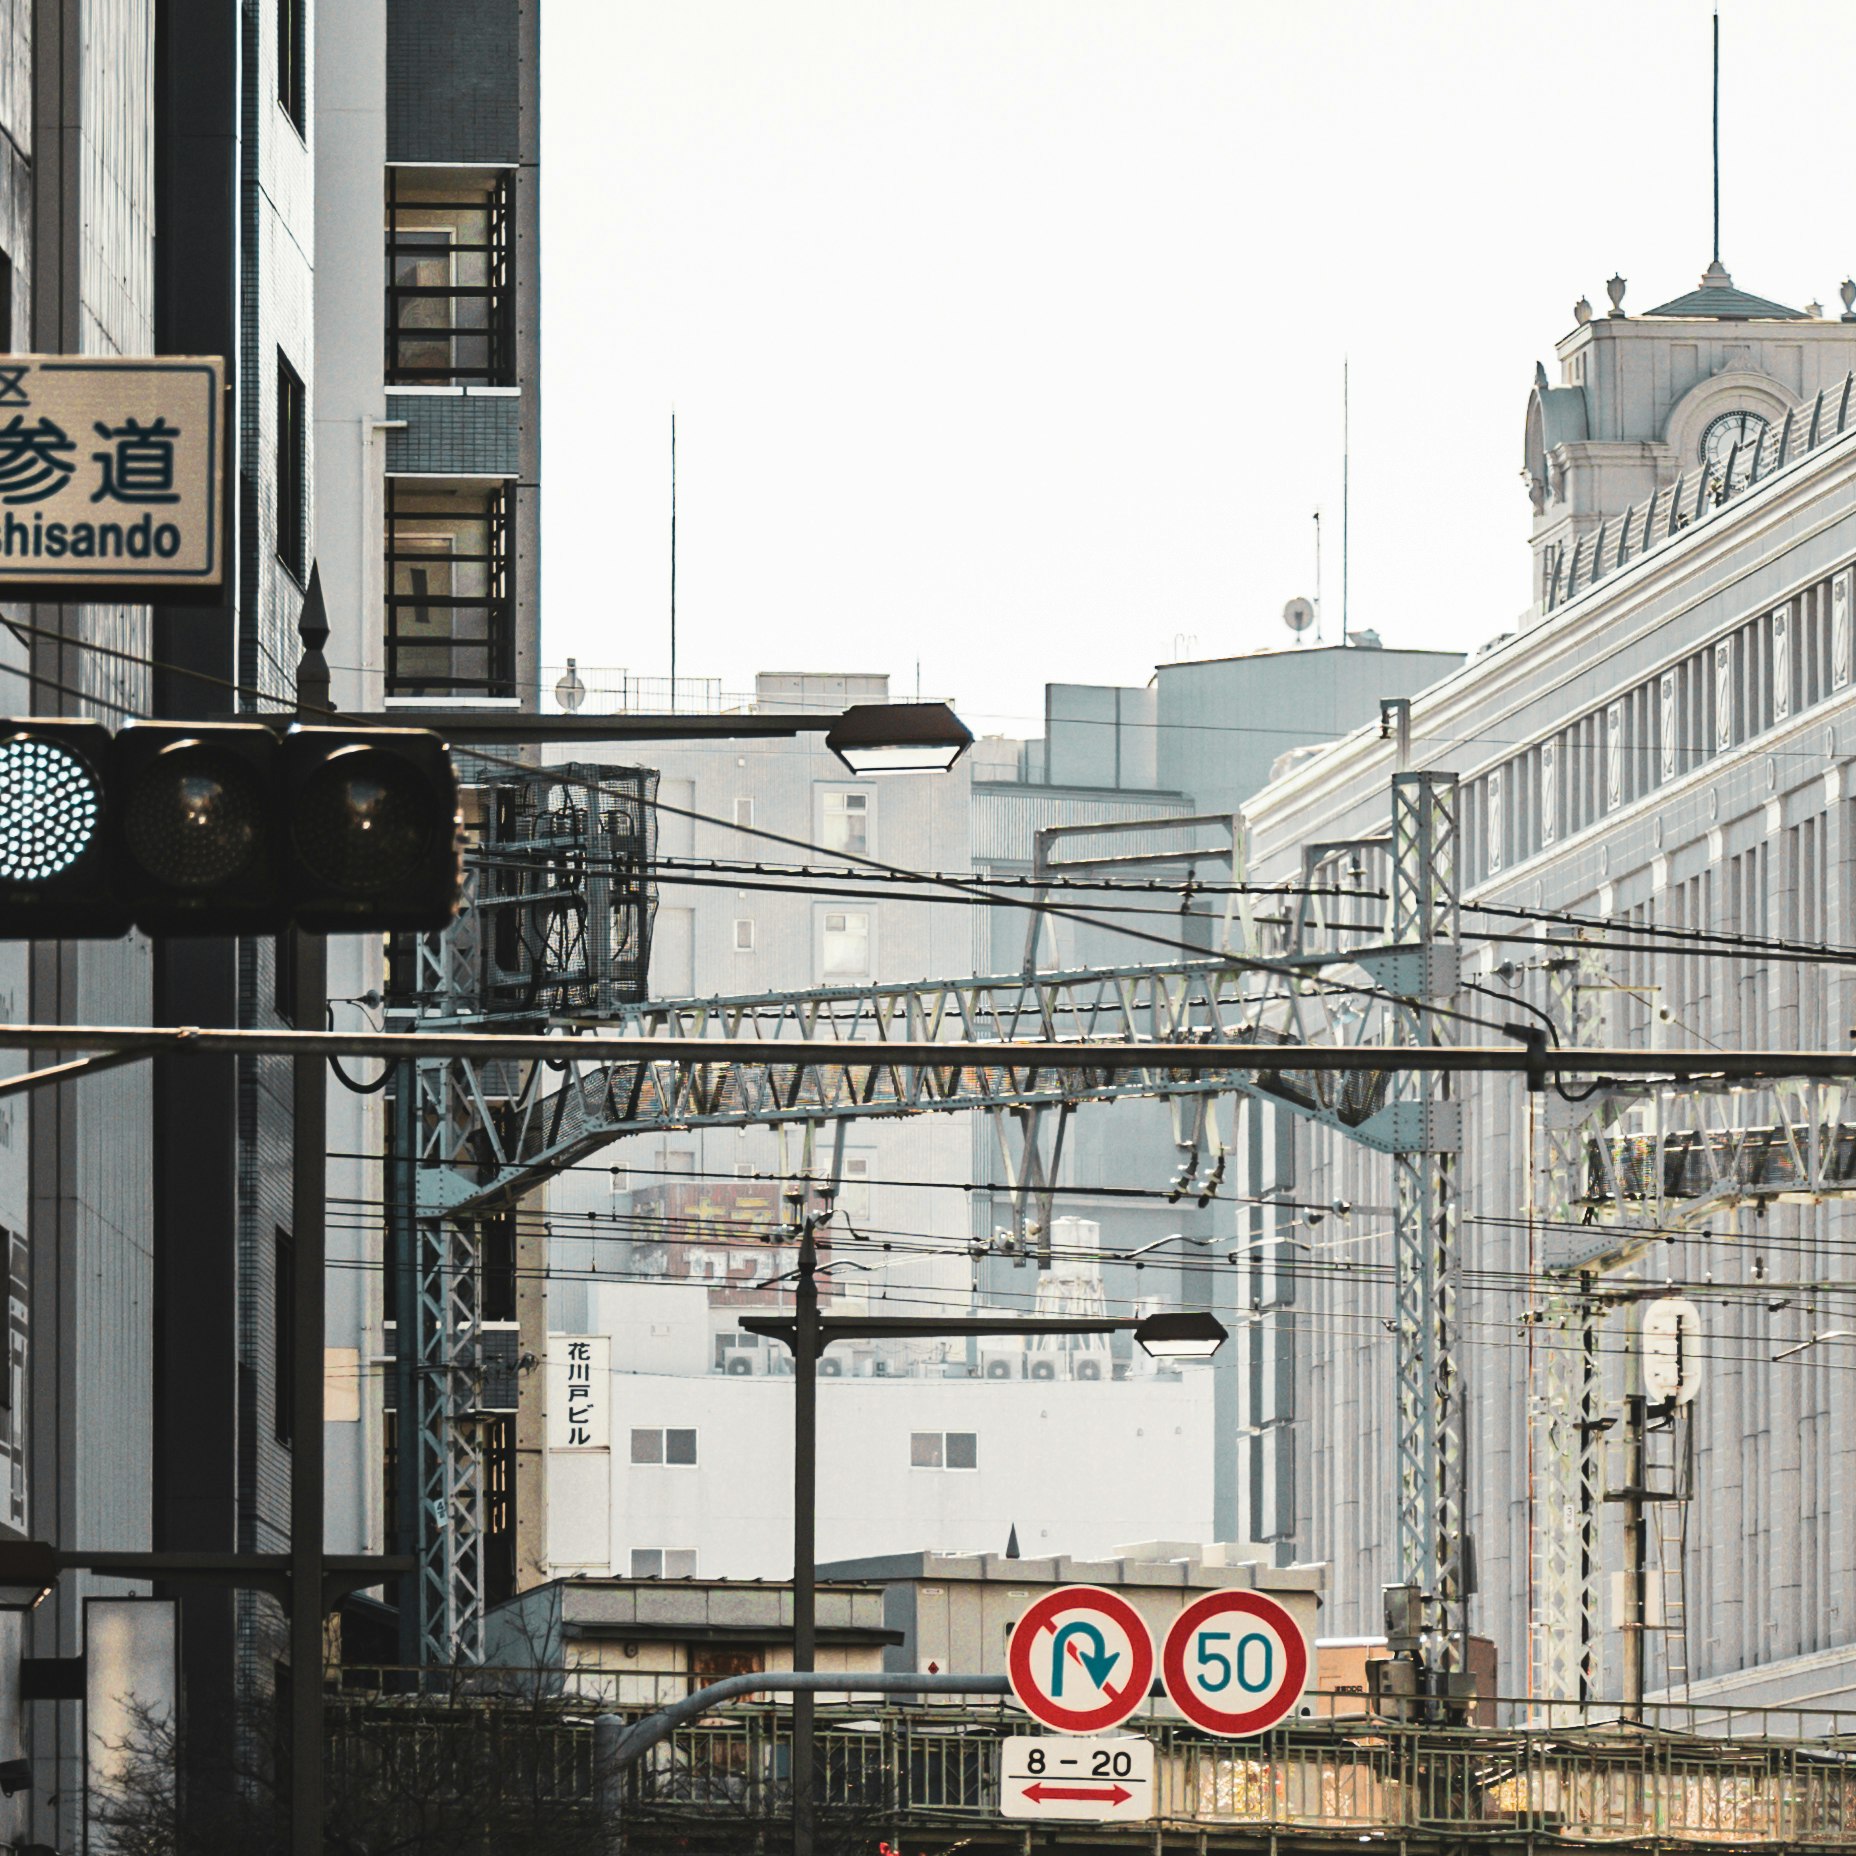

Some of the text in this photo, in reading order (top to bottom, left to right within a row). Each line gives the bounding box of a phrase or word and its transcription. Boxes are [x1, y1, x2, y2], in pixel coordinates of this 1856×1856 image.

[0, 414, 181, 505] 参道
[0, 511, 181, 558] hisando
[567, 1342, 591, 1446] 花川戸ビル
[1197, 1631, 1273, 1693] 50
[1027, 1749, 1046, 1775] 8
[1091, 1751, 1132, 1777] 20
